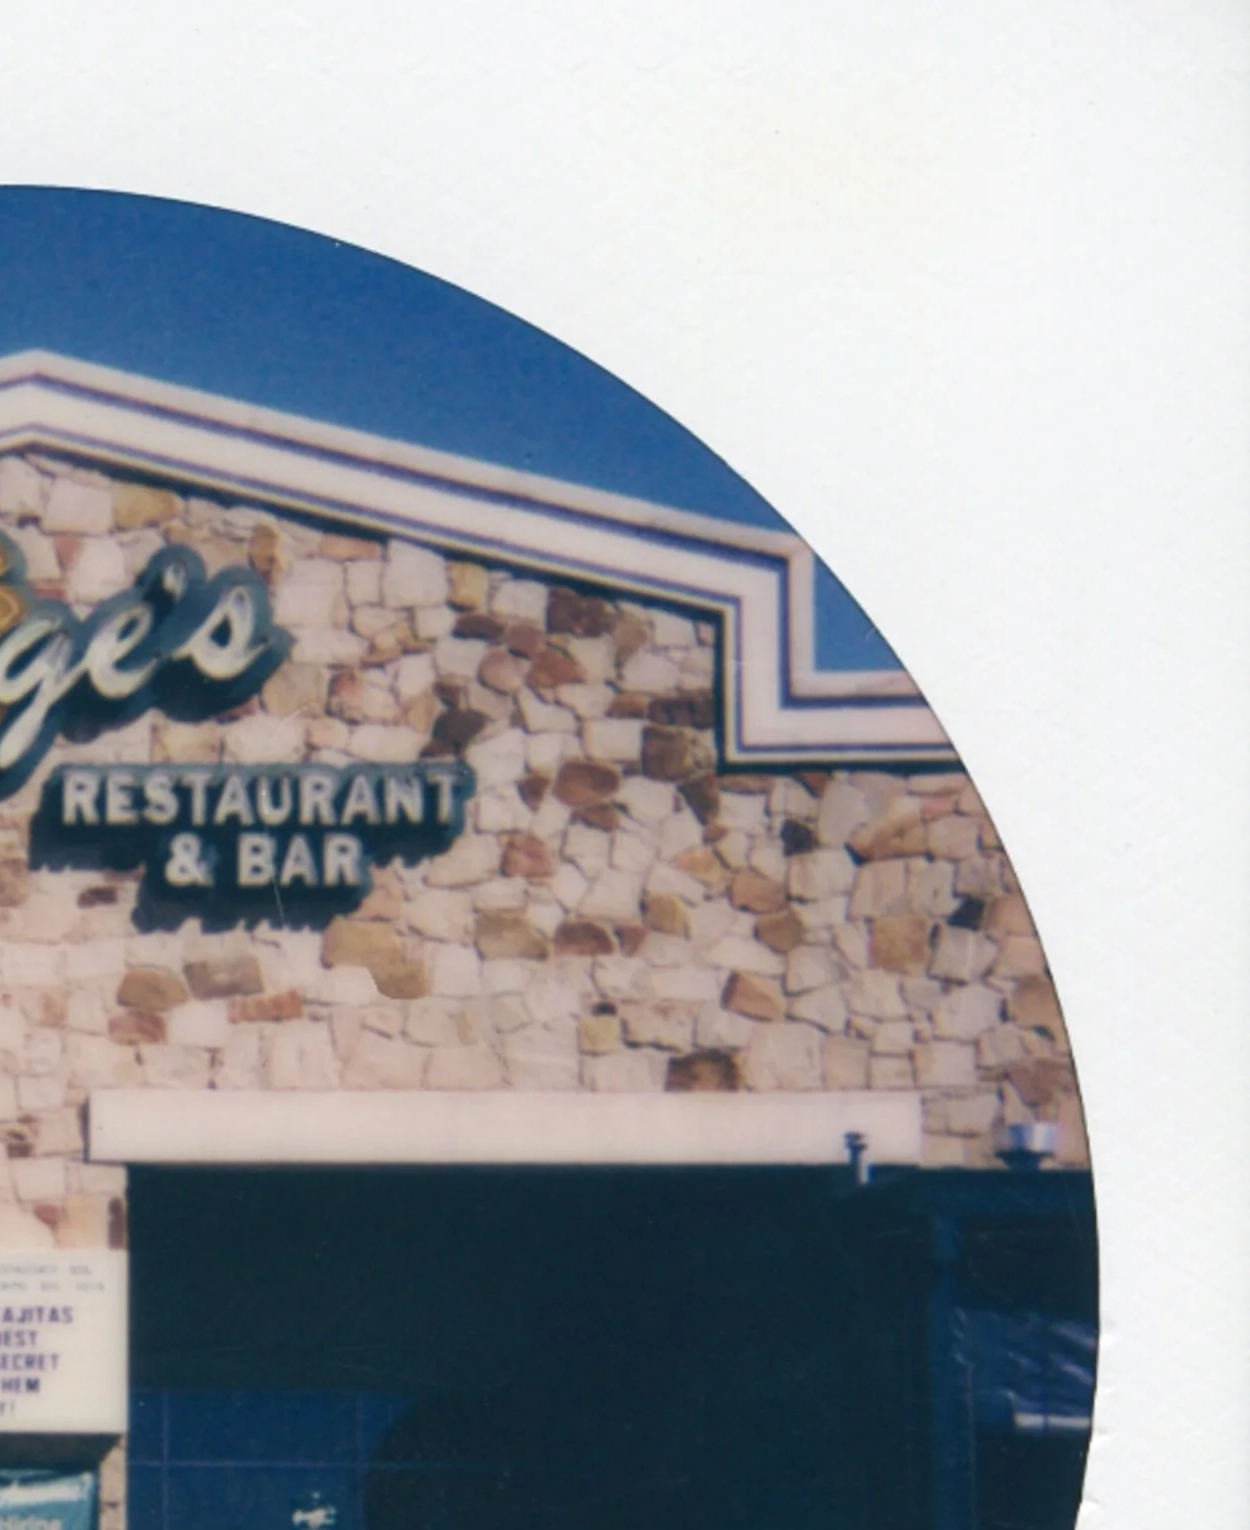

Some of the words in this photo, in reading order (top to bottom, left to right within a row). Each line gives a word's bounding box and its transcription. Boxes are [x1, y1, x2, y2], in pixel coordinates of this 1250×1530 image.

[61, 769, 465, 828] RESTAURANT
[163, 834, 215, 888] &
[236, 834, 364, 888] BAR
